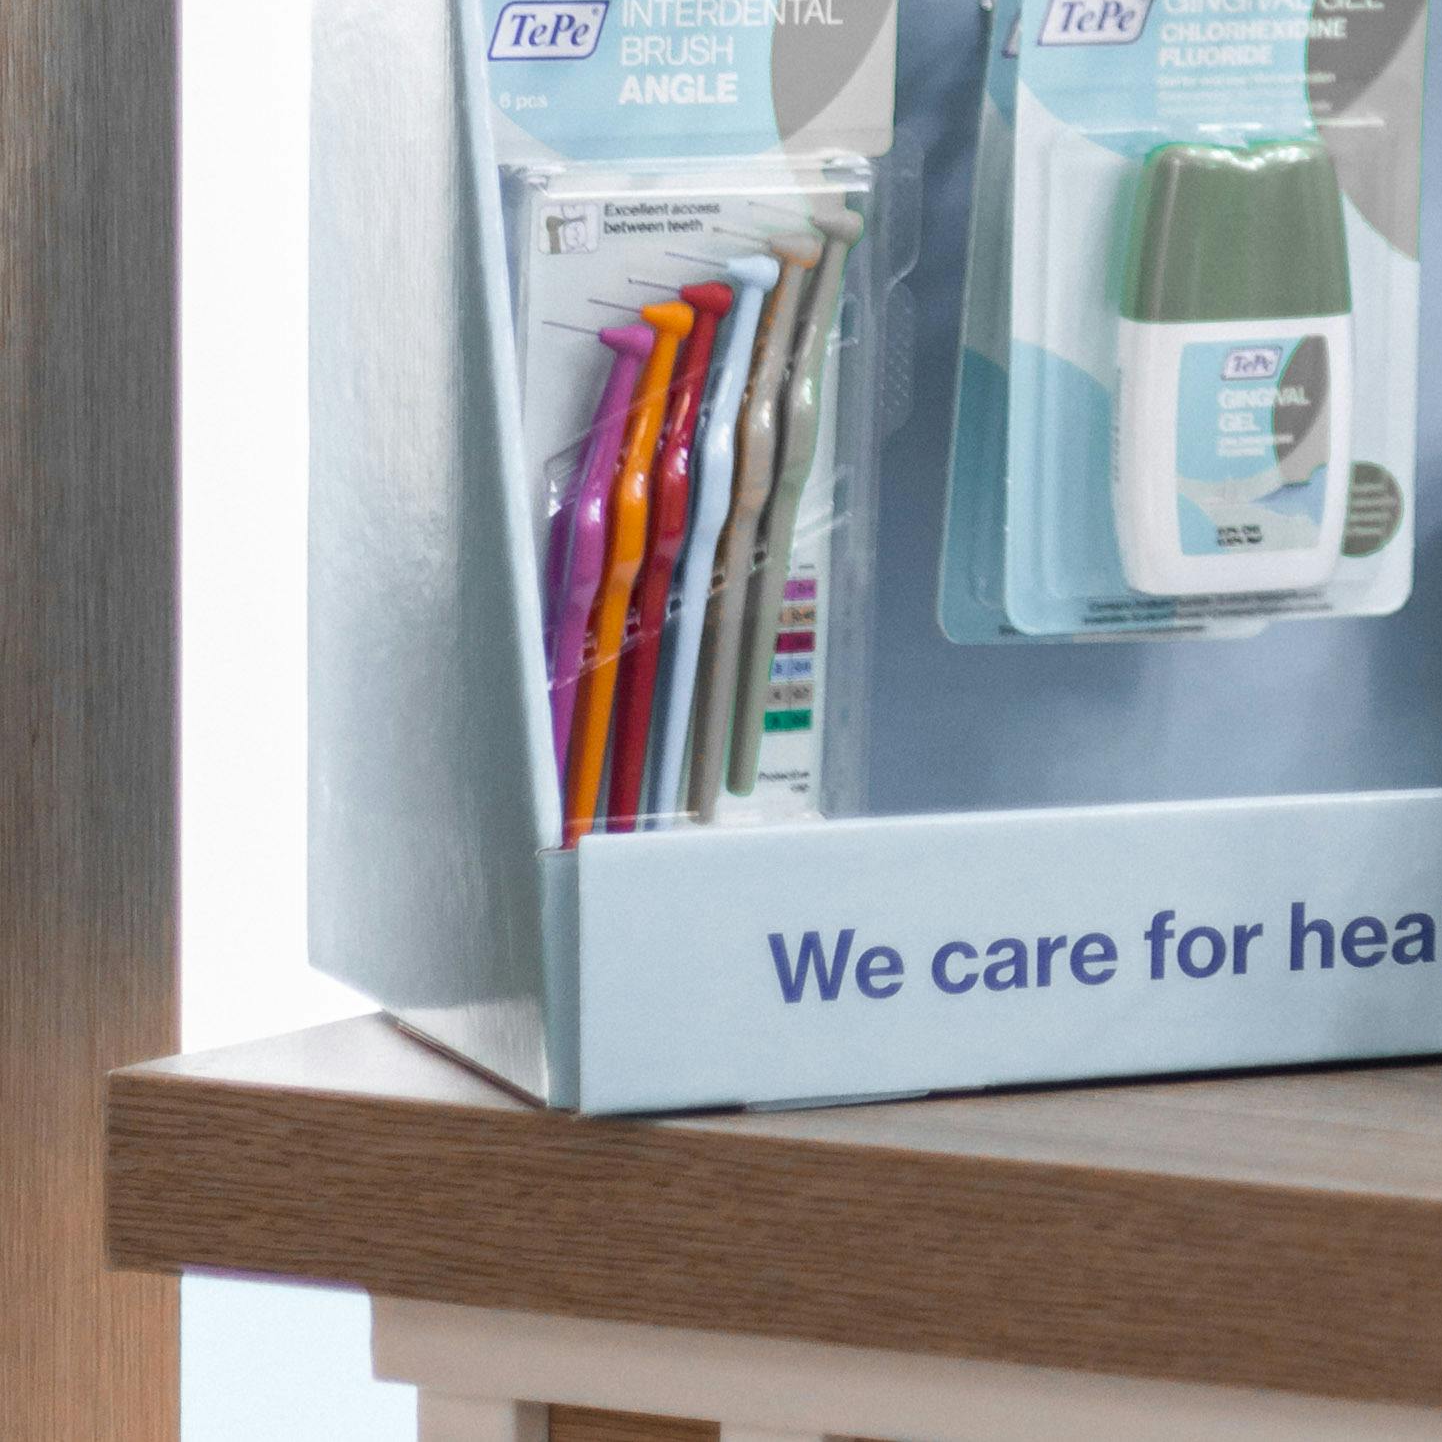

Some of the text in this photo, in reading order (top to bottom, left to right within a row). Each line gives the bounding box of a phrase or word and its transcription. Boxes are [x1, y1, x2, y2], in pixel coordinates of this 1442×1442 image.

[510, 13, 591, 49] TePe
[620, 36, 733, 66] BRUSH
[1157, 44, 1274, 67] FLUORIDE
[619, 72, 739, 106] ANGLE
[603, 201, 720, 217] Excellent access
[603, 218, 704, 235] between teeth
[767, 928, 906, 1004] We
[930, 931, 1118, 995] care
[1144, 909, 1263, 981] for
